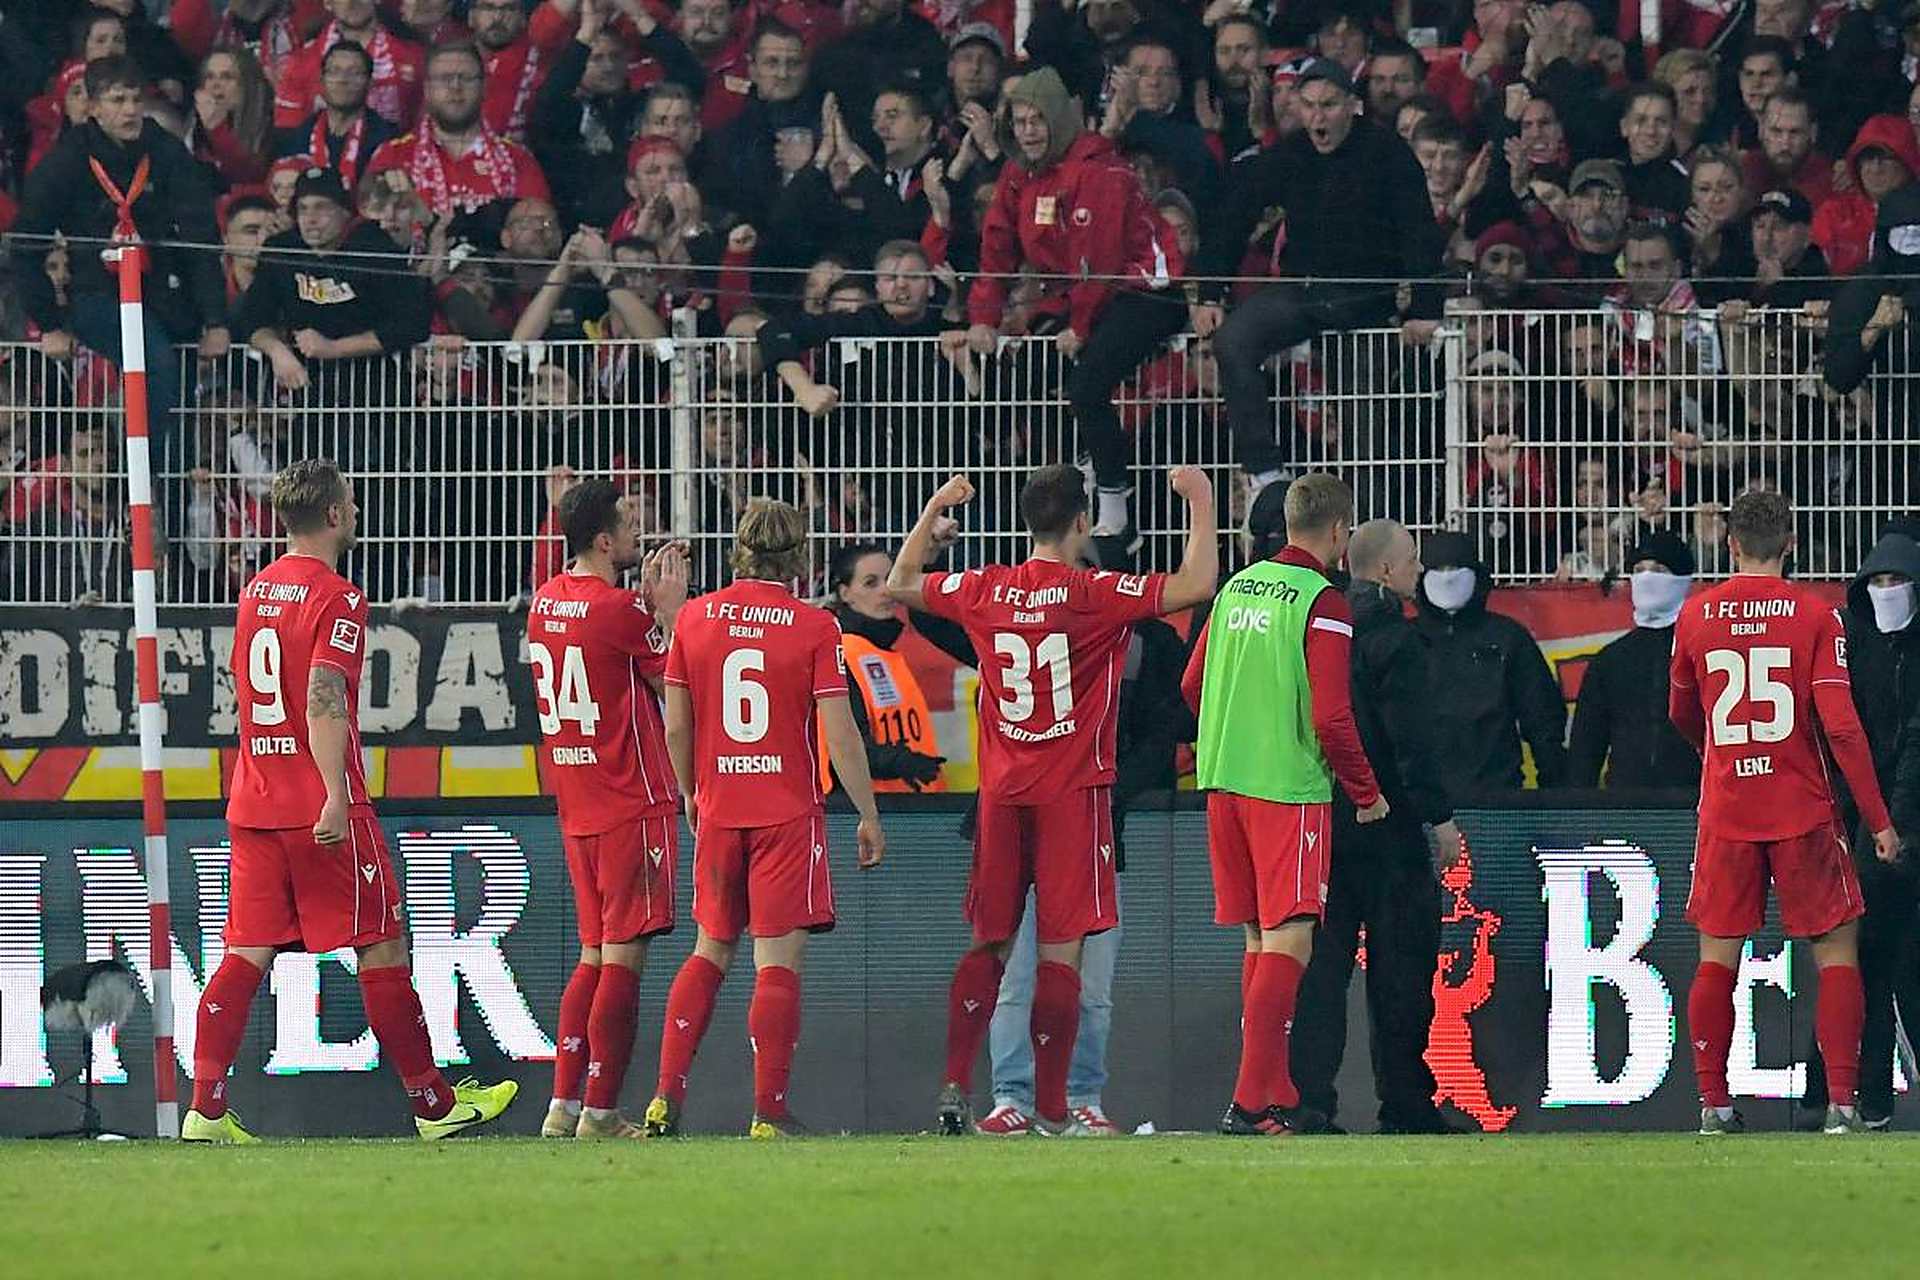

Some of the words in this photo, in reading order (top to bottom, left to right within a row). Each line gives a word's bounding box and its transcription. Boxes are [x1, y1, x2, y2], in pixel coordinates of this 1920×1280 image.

[253, 581, 269, 599] FC
[268, 583, 309, 604] UNION
[993, 584, 1003, 602] 1.
[1004, 586, 1024, 606] FC
[1025, 586, 1069, 609] UNION
[537, 597, 553, 616] FC
[705, 600, 715, 619] 1.
[718, 603, 741, 620] FC
[742, 606, 795, 625] UNION
[1703, 602, 1714, 619] 1.
[1718, 601, 1739, 619] FC
[1743, 599, 1796, 618] UNION
[729, 625, 764, 639] BERLIN
[1731, 622, 1767, 636] BERLIN
[249, 626, 287, 726] 9
[994, 632, 1074, 722] 31
[528, 642, 601, 737] 34
[722, 647, 769, 744] 6
[1705, 647, 1795, 747] 25
[880, 707, 922, 744] 110
[717, 755, 782, 774] RYERSON
[1735, 756, 1774, 777] LENZ
